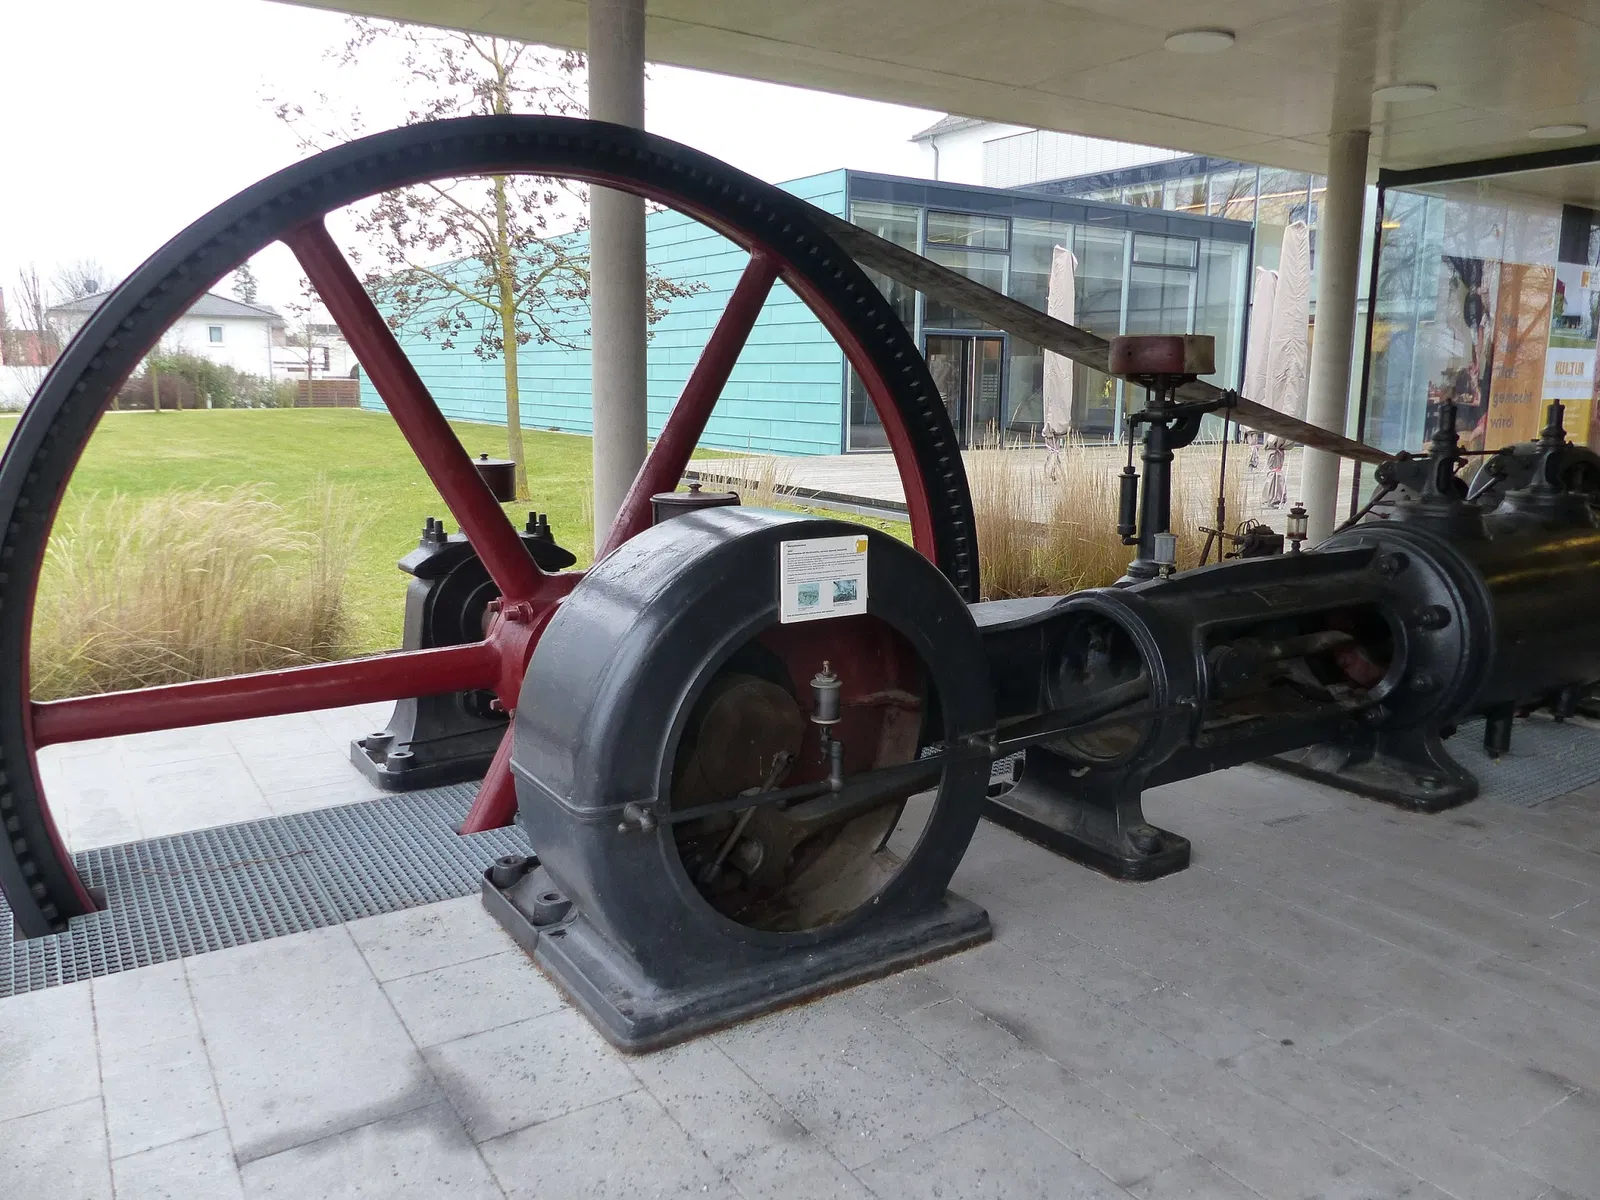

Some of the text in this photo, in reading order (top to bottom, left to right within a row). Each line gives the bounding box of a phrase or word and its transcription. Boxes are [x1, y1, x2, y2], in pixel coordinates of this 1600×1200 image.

[1555, 361, 1584, 376] KULTUR
[1493, 389, 1532, 408] gemacht
[1490, 414, 1514, 429] wird
